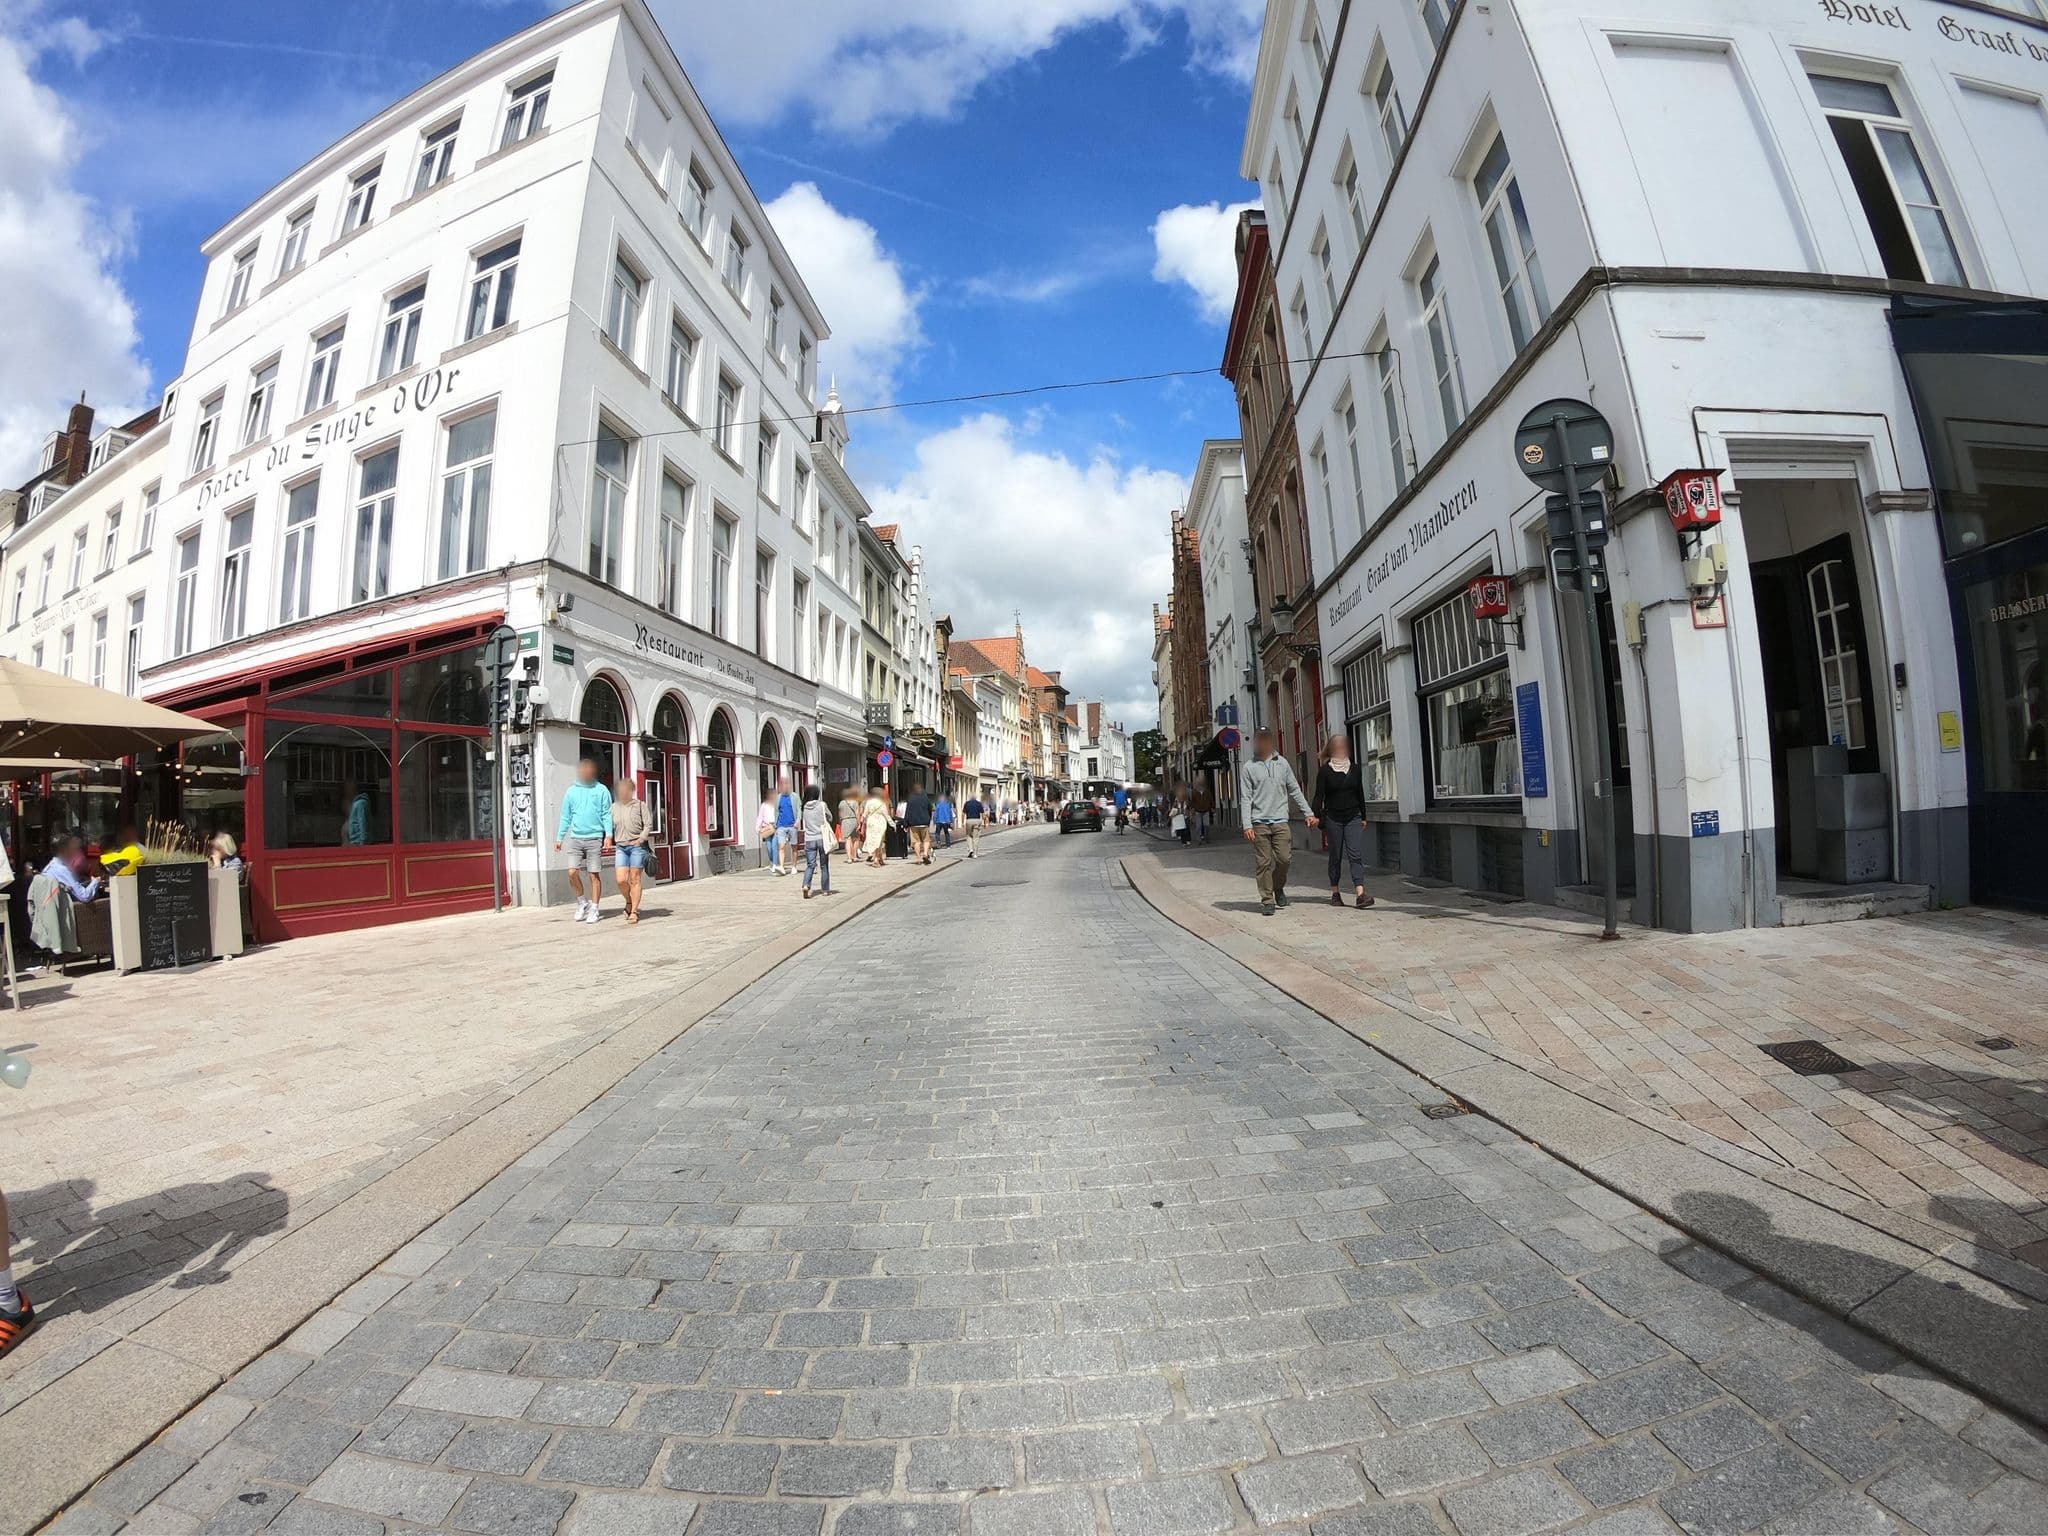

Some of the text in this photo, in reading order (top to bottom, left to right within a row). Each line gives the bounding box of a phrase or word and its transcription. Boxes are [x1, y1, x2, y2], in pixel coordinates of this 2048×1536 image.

[1818, 0, 1912, 31] Hotel
[1937, 15, 2022, 56] Graaf
[196, 458, 251, 511] Hotel
[266, 443, 290, 472] du
[301, 405, 377, 459] Singe
[1328, 479, 1479, 628] Restaurant Graaf van Vlaanderen
[635, 623, 704, 668] Restaurant
